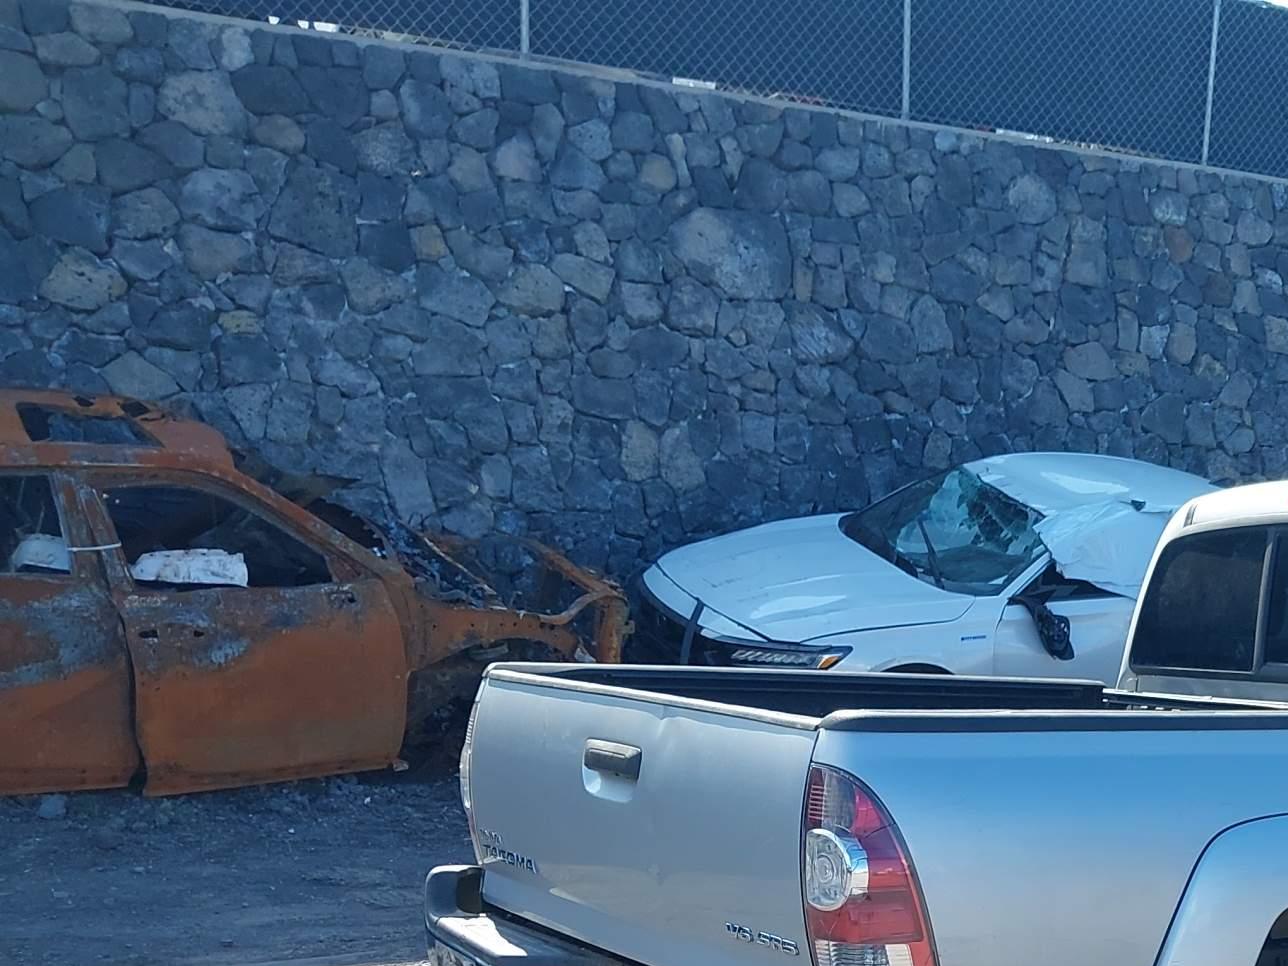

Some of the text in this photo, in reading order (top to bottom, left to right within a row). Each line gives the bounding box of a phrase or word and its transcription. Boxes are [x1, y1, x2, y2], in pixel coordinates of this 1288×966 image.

[482, 844, 537, 875] TACOMA
[725, 922, 800, 956] V6 SR5
